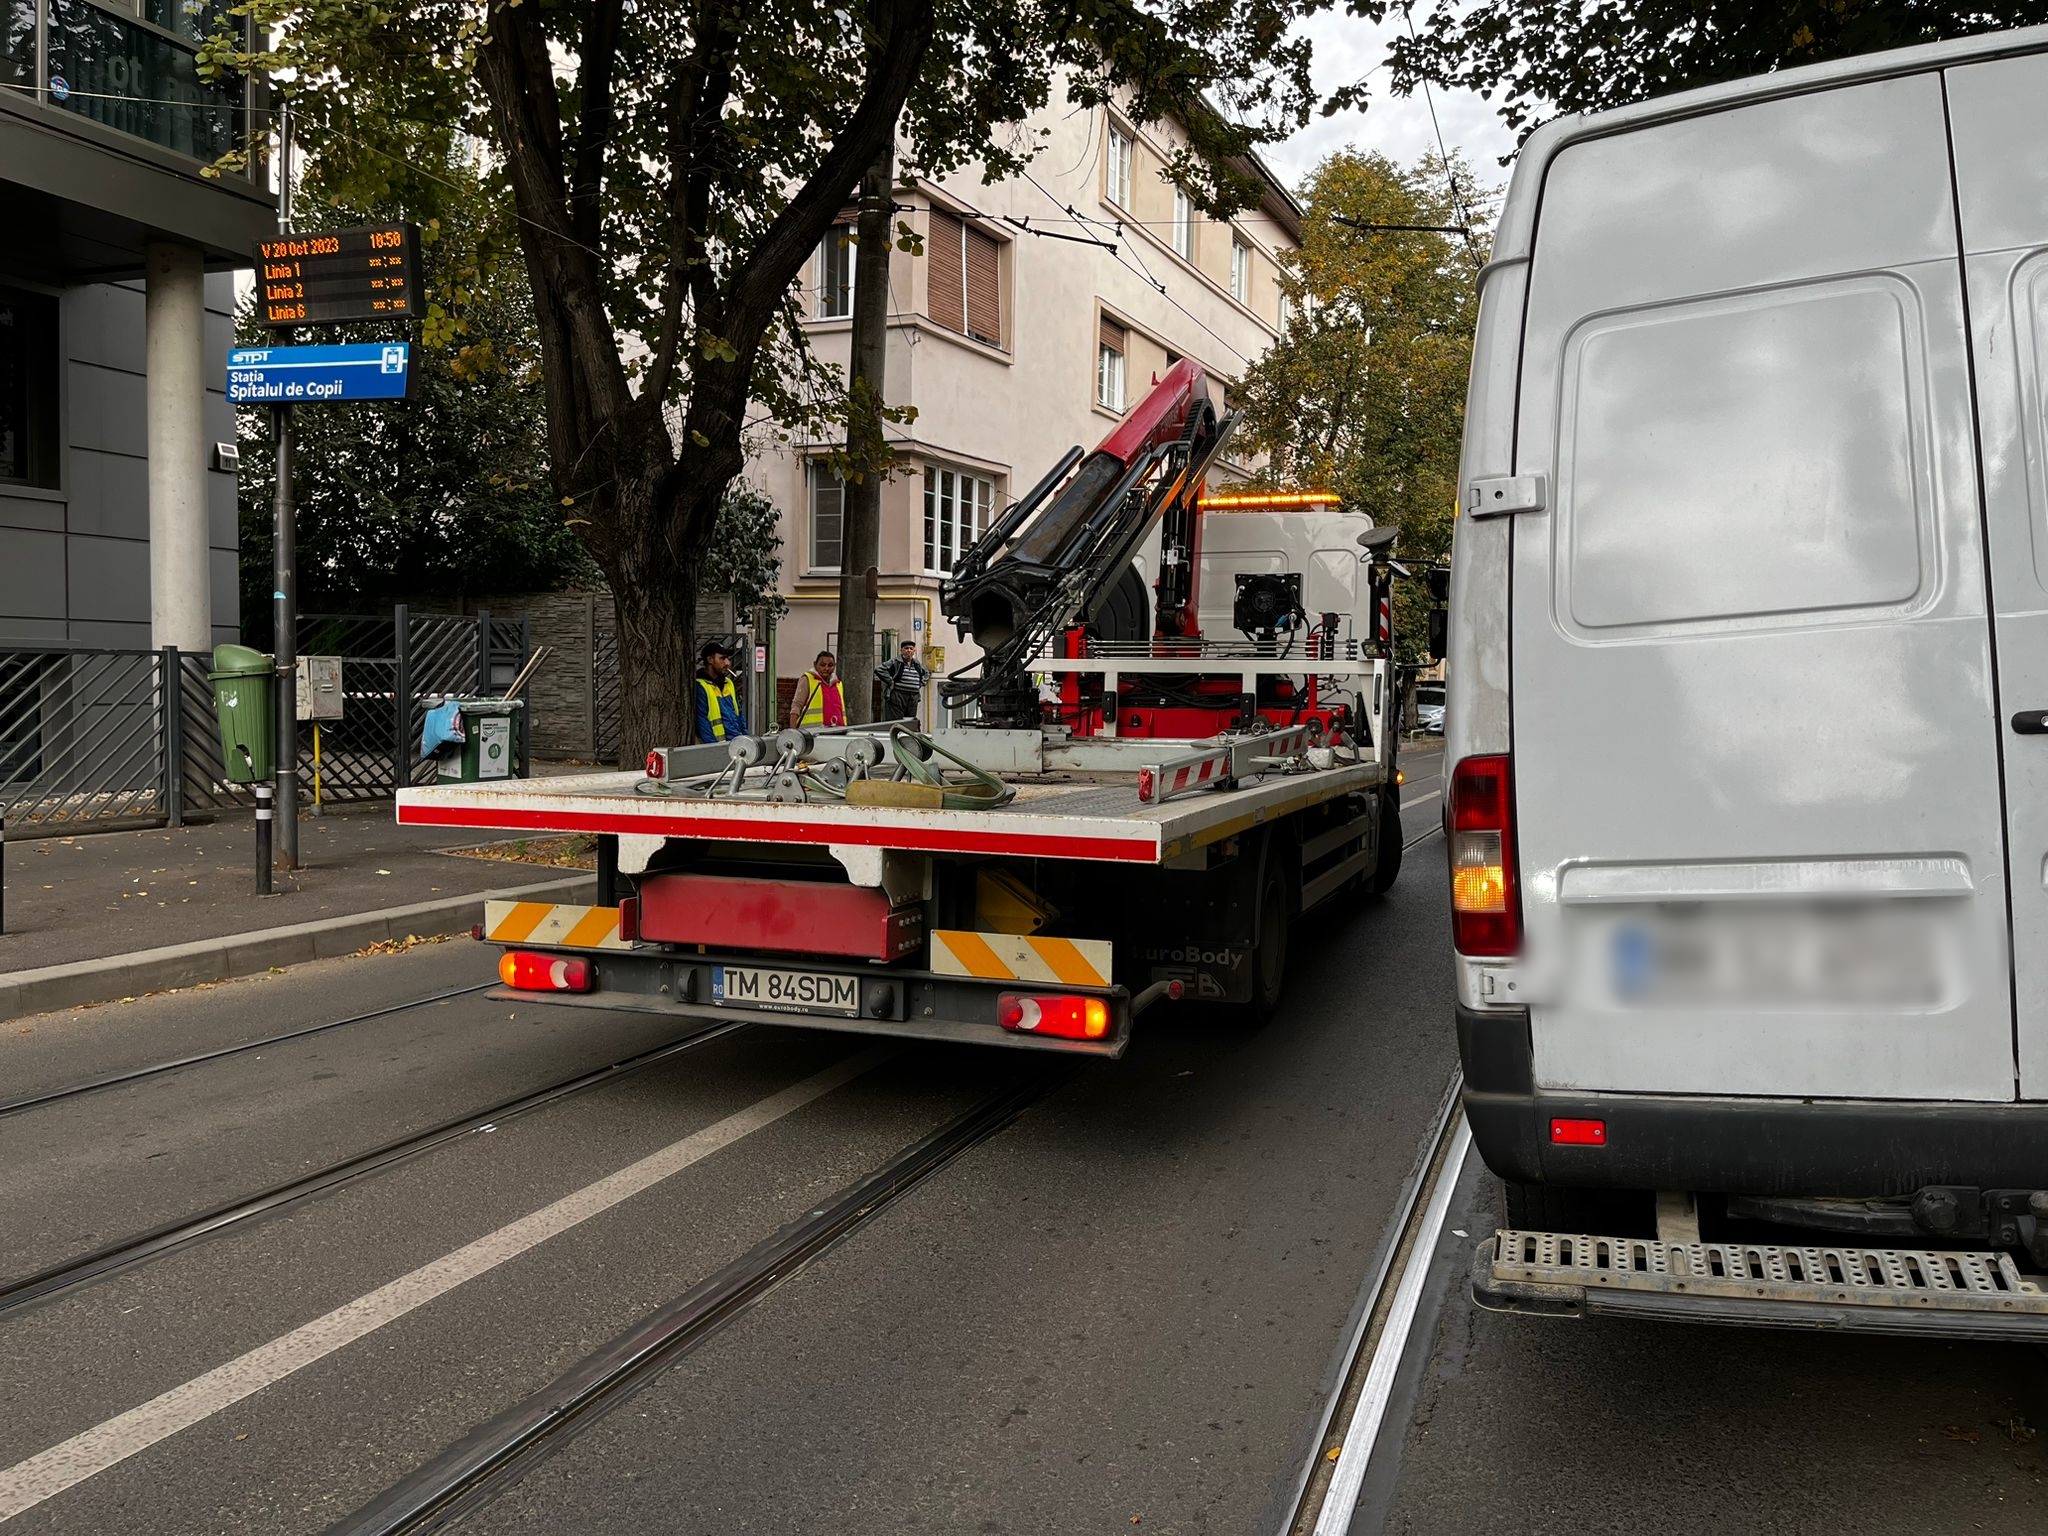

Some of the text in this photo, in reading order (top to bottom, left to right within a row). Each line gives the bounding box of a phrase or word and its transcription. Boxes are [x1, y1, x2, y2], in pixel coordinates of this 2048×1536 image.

[261, 243, 271, 259] V
[289, 240, 309, 256] Oct
[311, 237, 340, 254] 2023
[369, 231, 401, 248] 10:50
[264, 262, 301, 280] Linia 1
[266, 283, 304, 300] Linia 2
[268, 303, 306, 321] Linia 6
[229, 379, 343, 401] Spitalul de Copii
[712, 983, 724, 995] RO
[724, 970, 856, 1006] TM 84SDM
